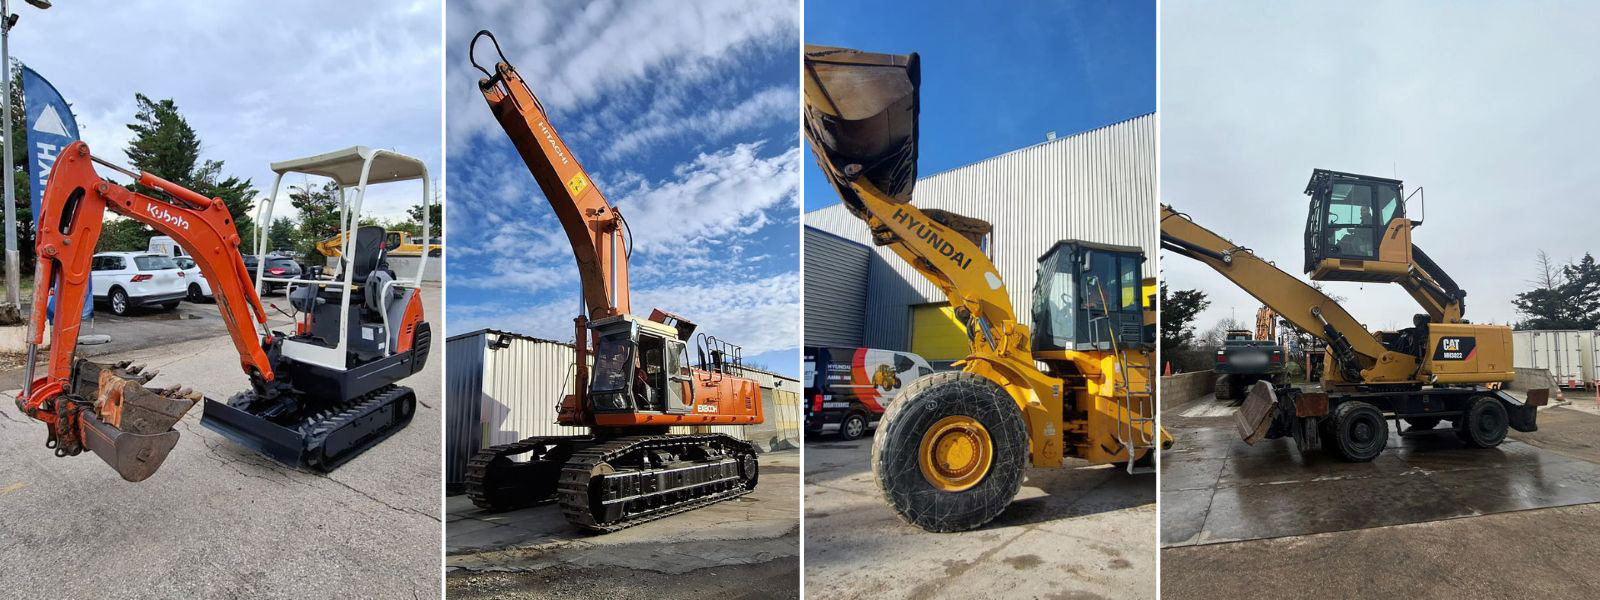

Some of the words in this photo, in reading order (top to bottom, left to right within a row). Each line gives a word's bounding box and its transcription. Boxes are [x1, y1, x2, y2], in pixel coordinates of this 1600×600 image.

[538, 121, 568, 165] HITACHI
[146, 202, 189, 230] Kubota
[892, 208, 972, 270] HYUNDAI
[1443, 339, 1460, 351] CAT
